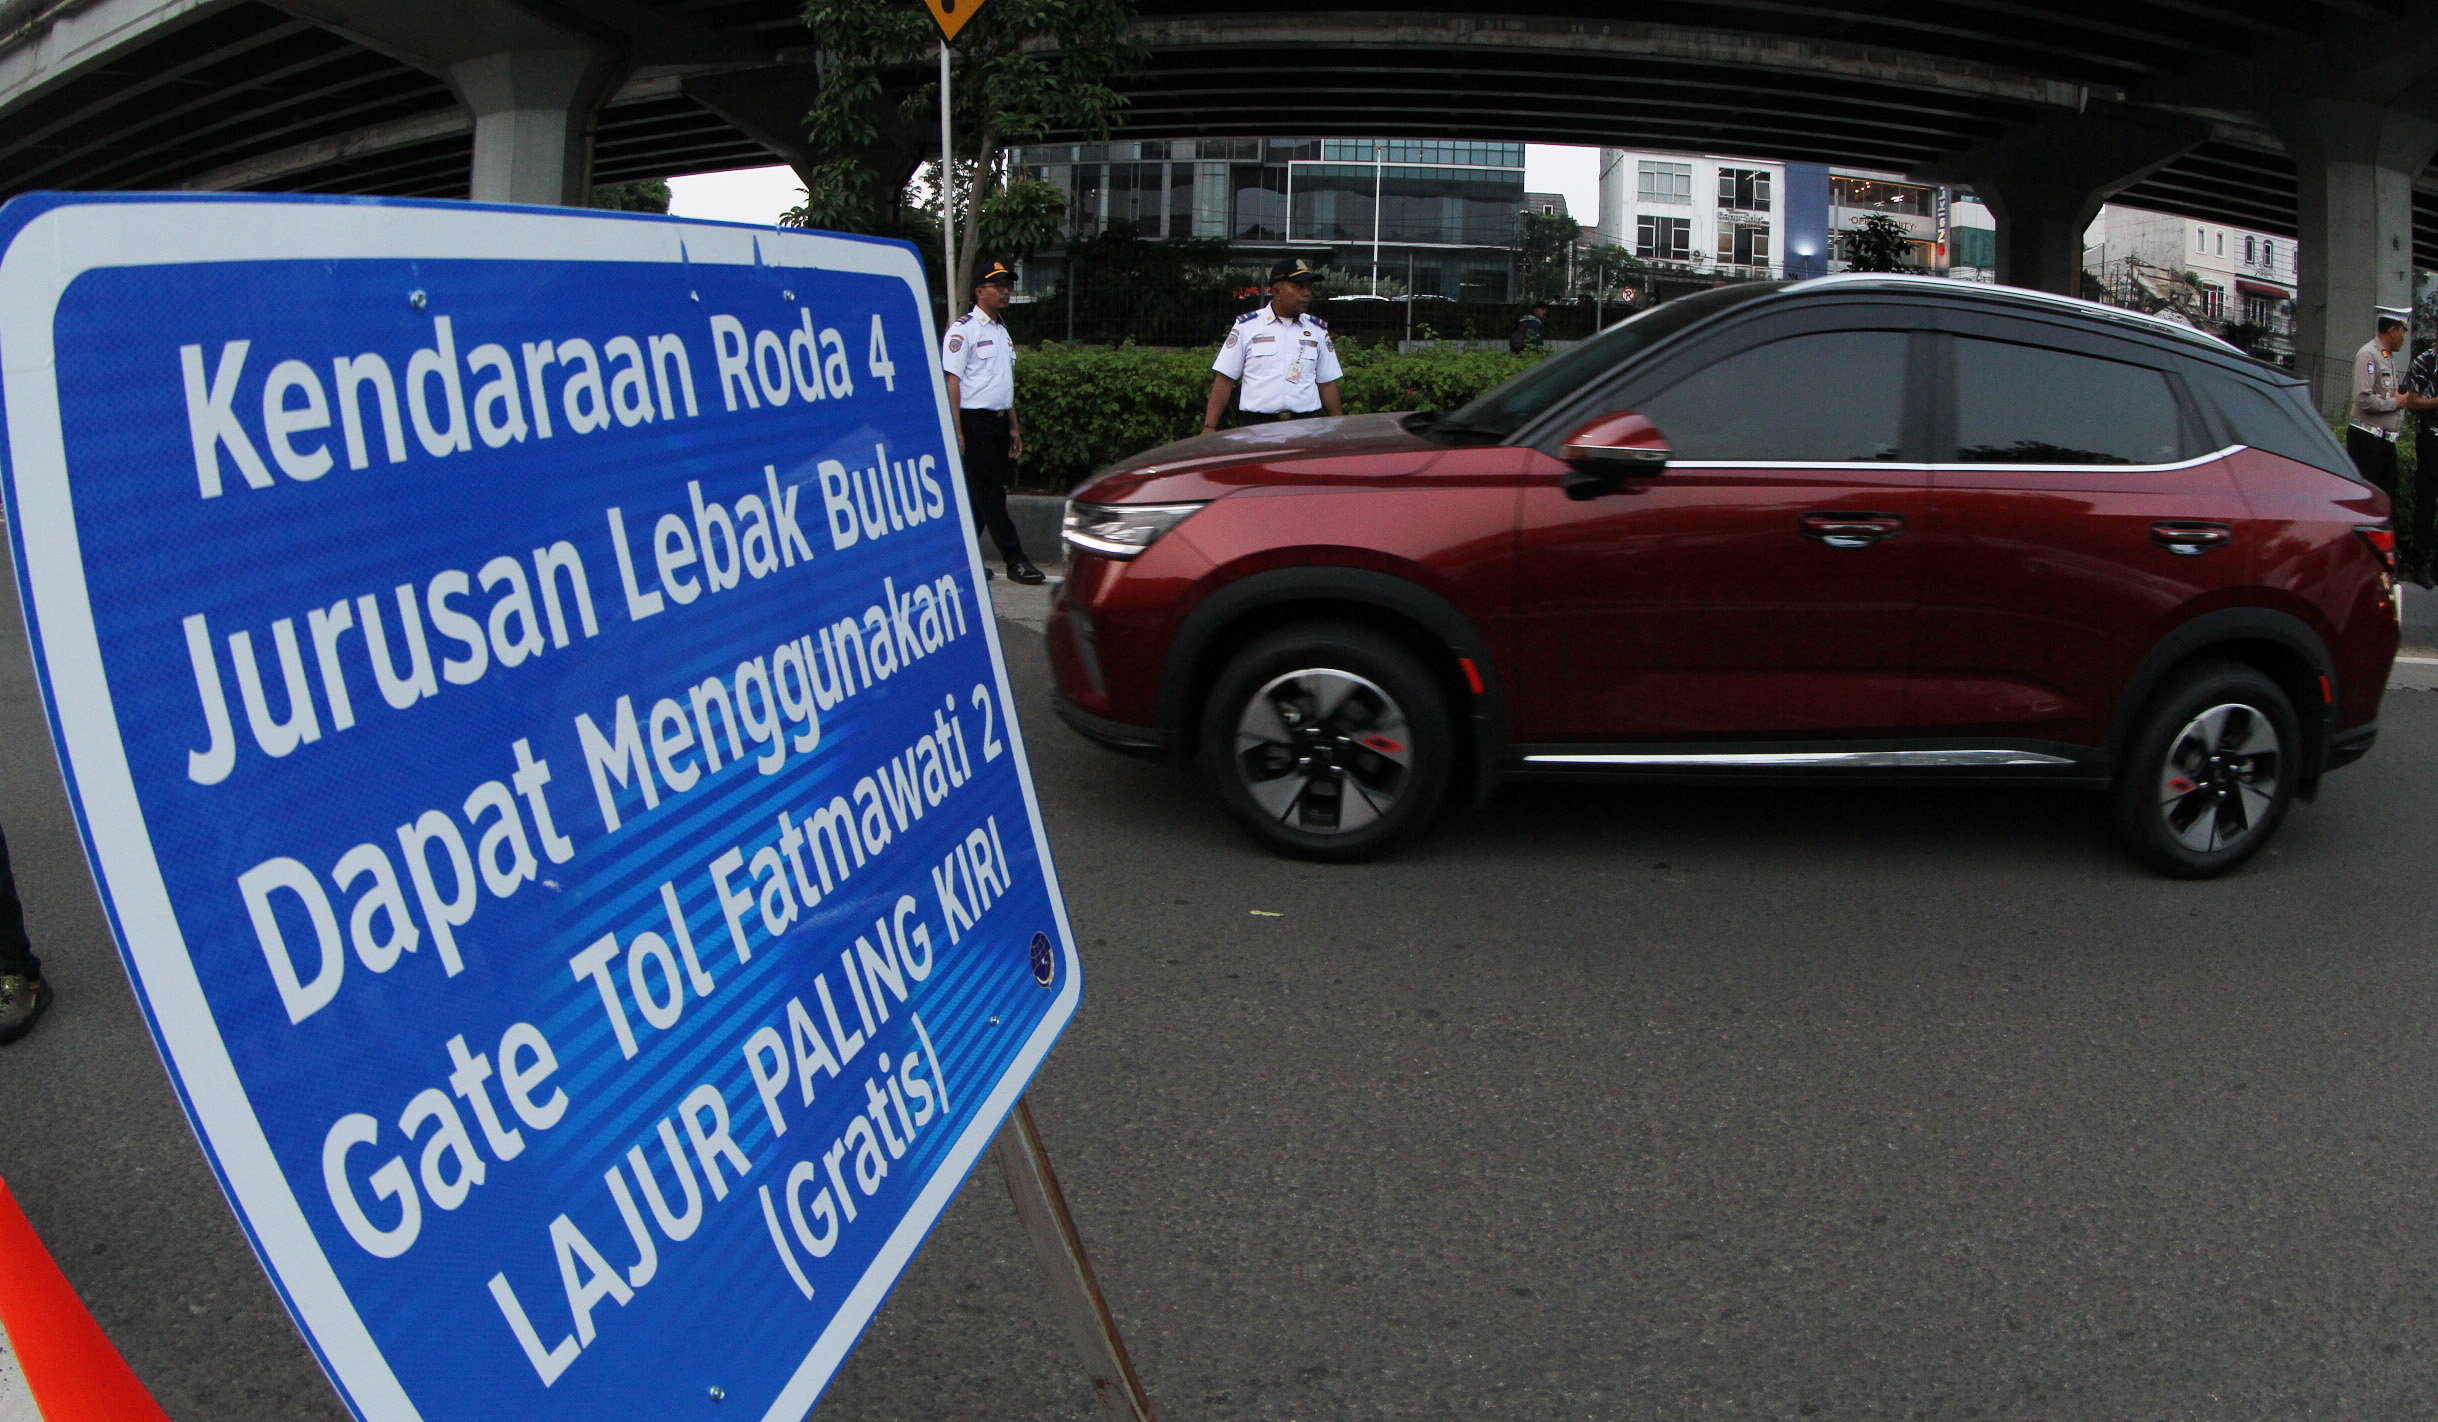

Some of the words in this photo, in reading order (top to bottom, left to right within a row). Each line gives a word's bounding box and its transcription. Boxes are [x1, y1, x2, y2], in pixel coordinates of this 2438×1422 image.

[1850, 215, 1915, 230] OPPNITY
[180, 316, 698, 498] Kendaraan
[710, 309, 853, 411] Roda
[869, 315, 896, 391] 4
[183, 541, 598, 785] Jurusan
[607, 465, 813, 621] Lebak
[818, 444, 944, 550] Bulus
[238, 738, 574, 1025] Dapat
[575, 575, 966, 833] Menggunakan
[322, 1023, 569, 1258] Gate
[569, 881, 715, 1060] Tol
[709, 696, 971, 964] Fatmawati
[972, 684, 1002, 762] 2
[488, 1084, 752, 1387] LAJUR
[743, 895, 932, 1137] PALING
[932, 816, 1011, 945] KIRI
[759, 1012, 949, 1300] (Gratis)
